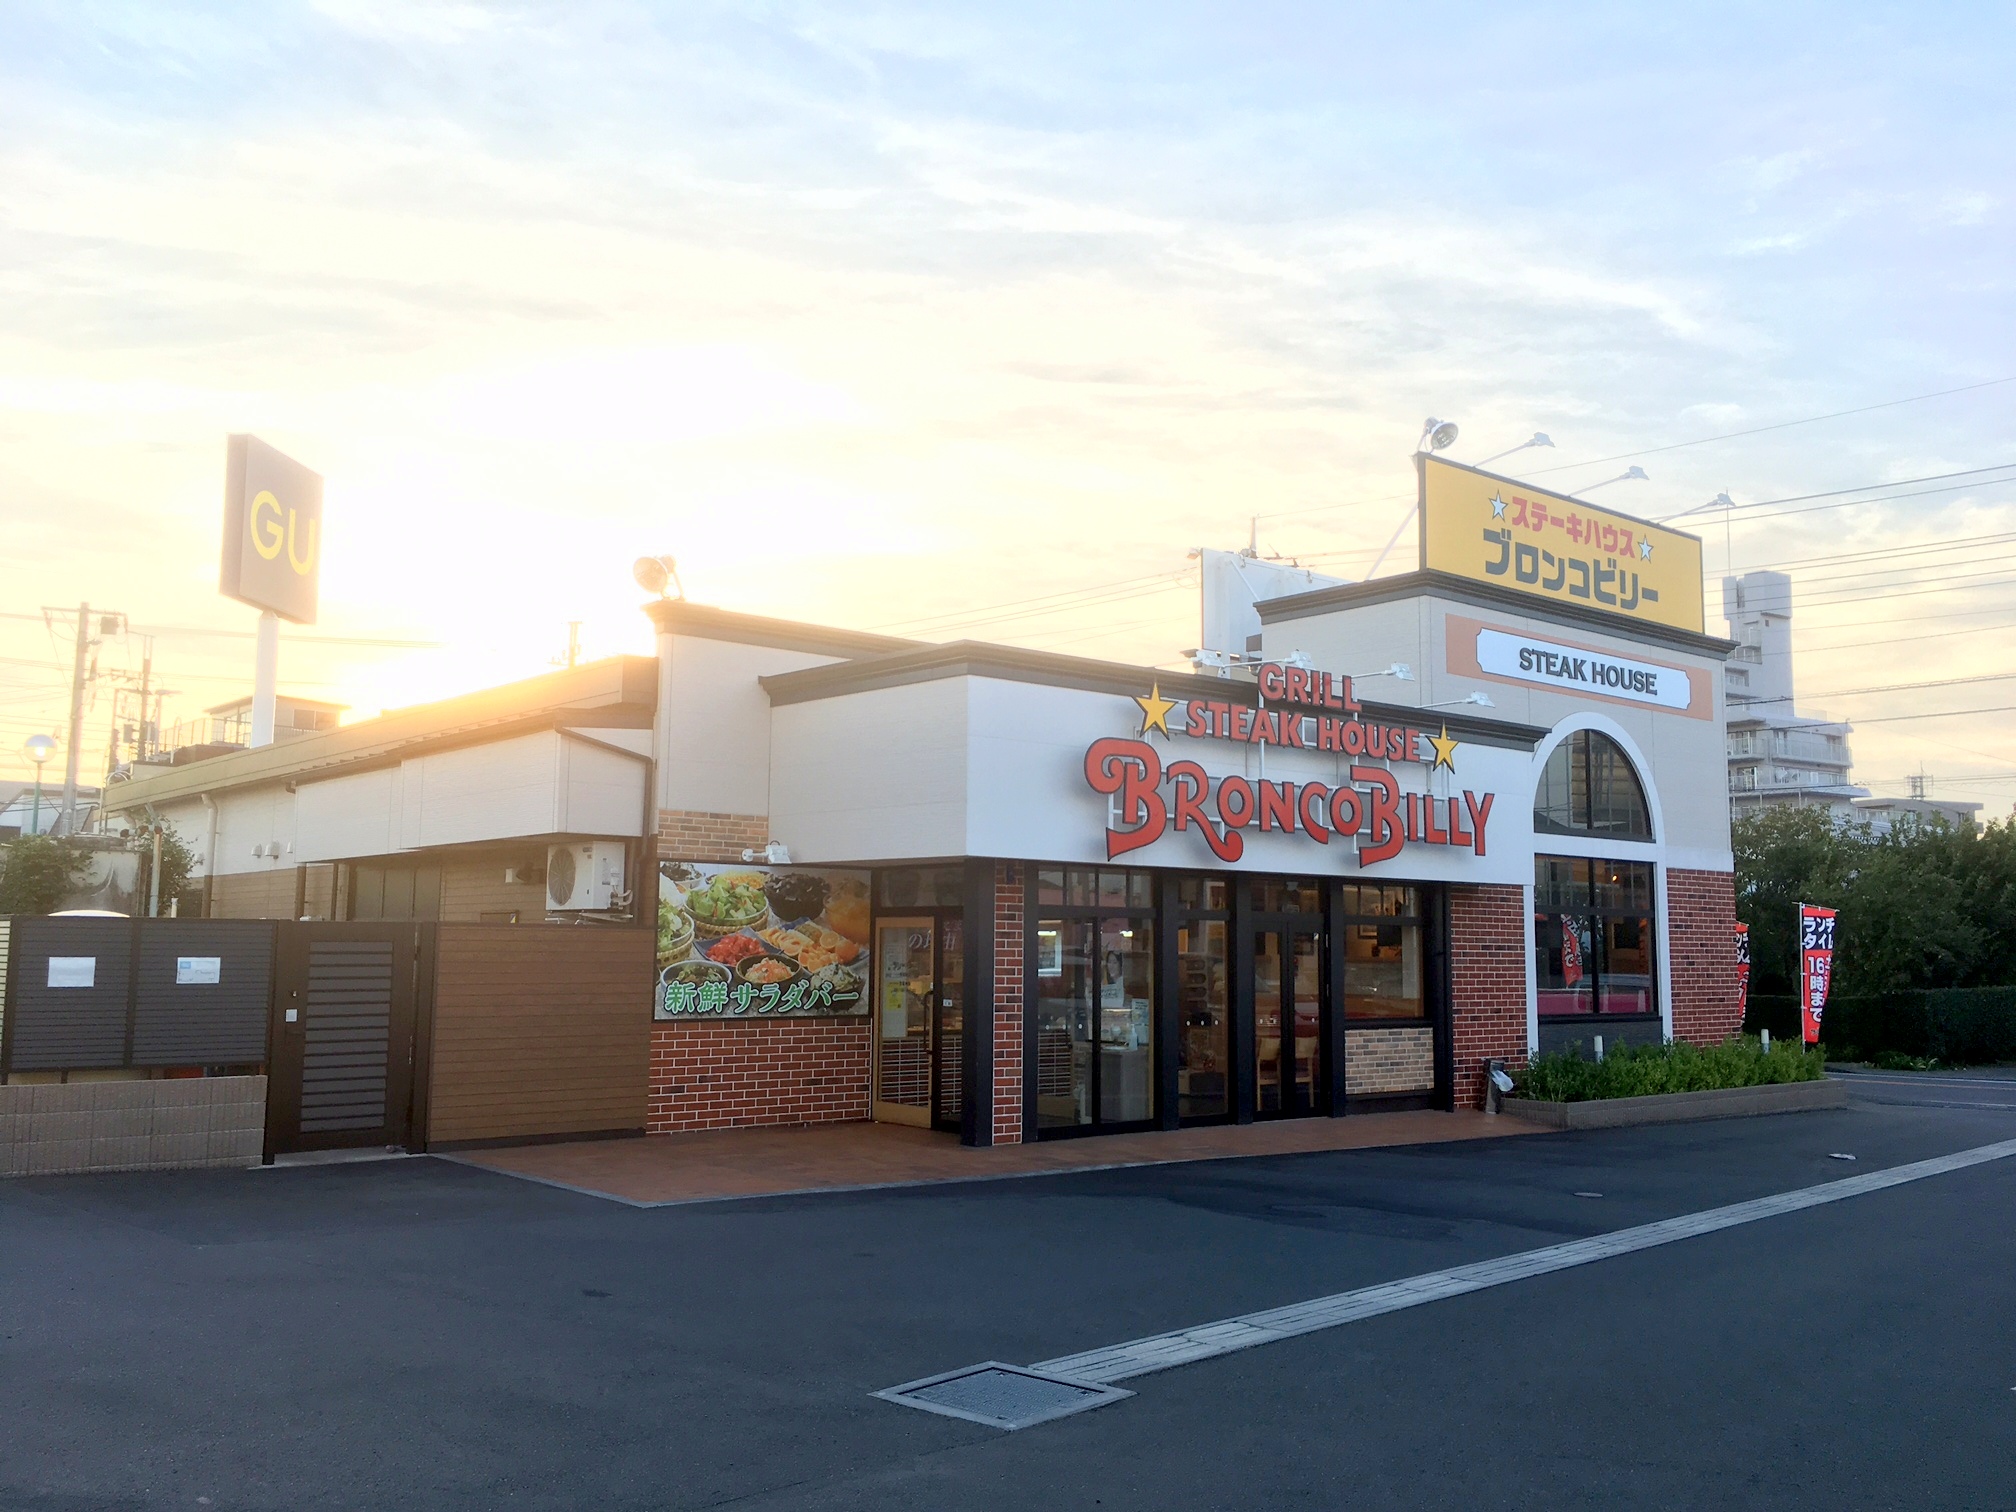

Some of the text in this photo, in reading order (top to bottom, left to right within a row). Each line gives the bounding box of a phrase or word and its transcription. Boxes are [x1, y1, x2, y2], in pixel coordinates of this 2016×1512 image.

[250, 490, 316, 576] GU
[1511, 495, 1636, 559] ステーキハウス
[1482, 527, 1659, 611] ブロンコビリー
[1257, 662, 1363, 714] GRILL
[1519, 647, 1658, 696] STEAK HOUSE
[1185, 699, 1421, 763] STEAK HOUSE
[1803, 916, 1836, 933] ランチ
[663, 979, 860, 1015] 新鮮サラダバー
